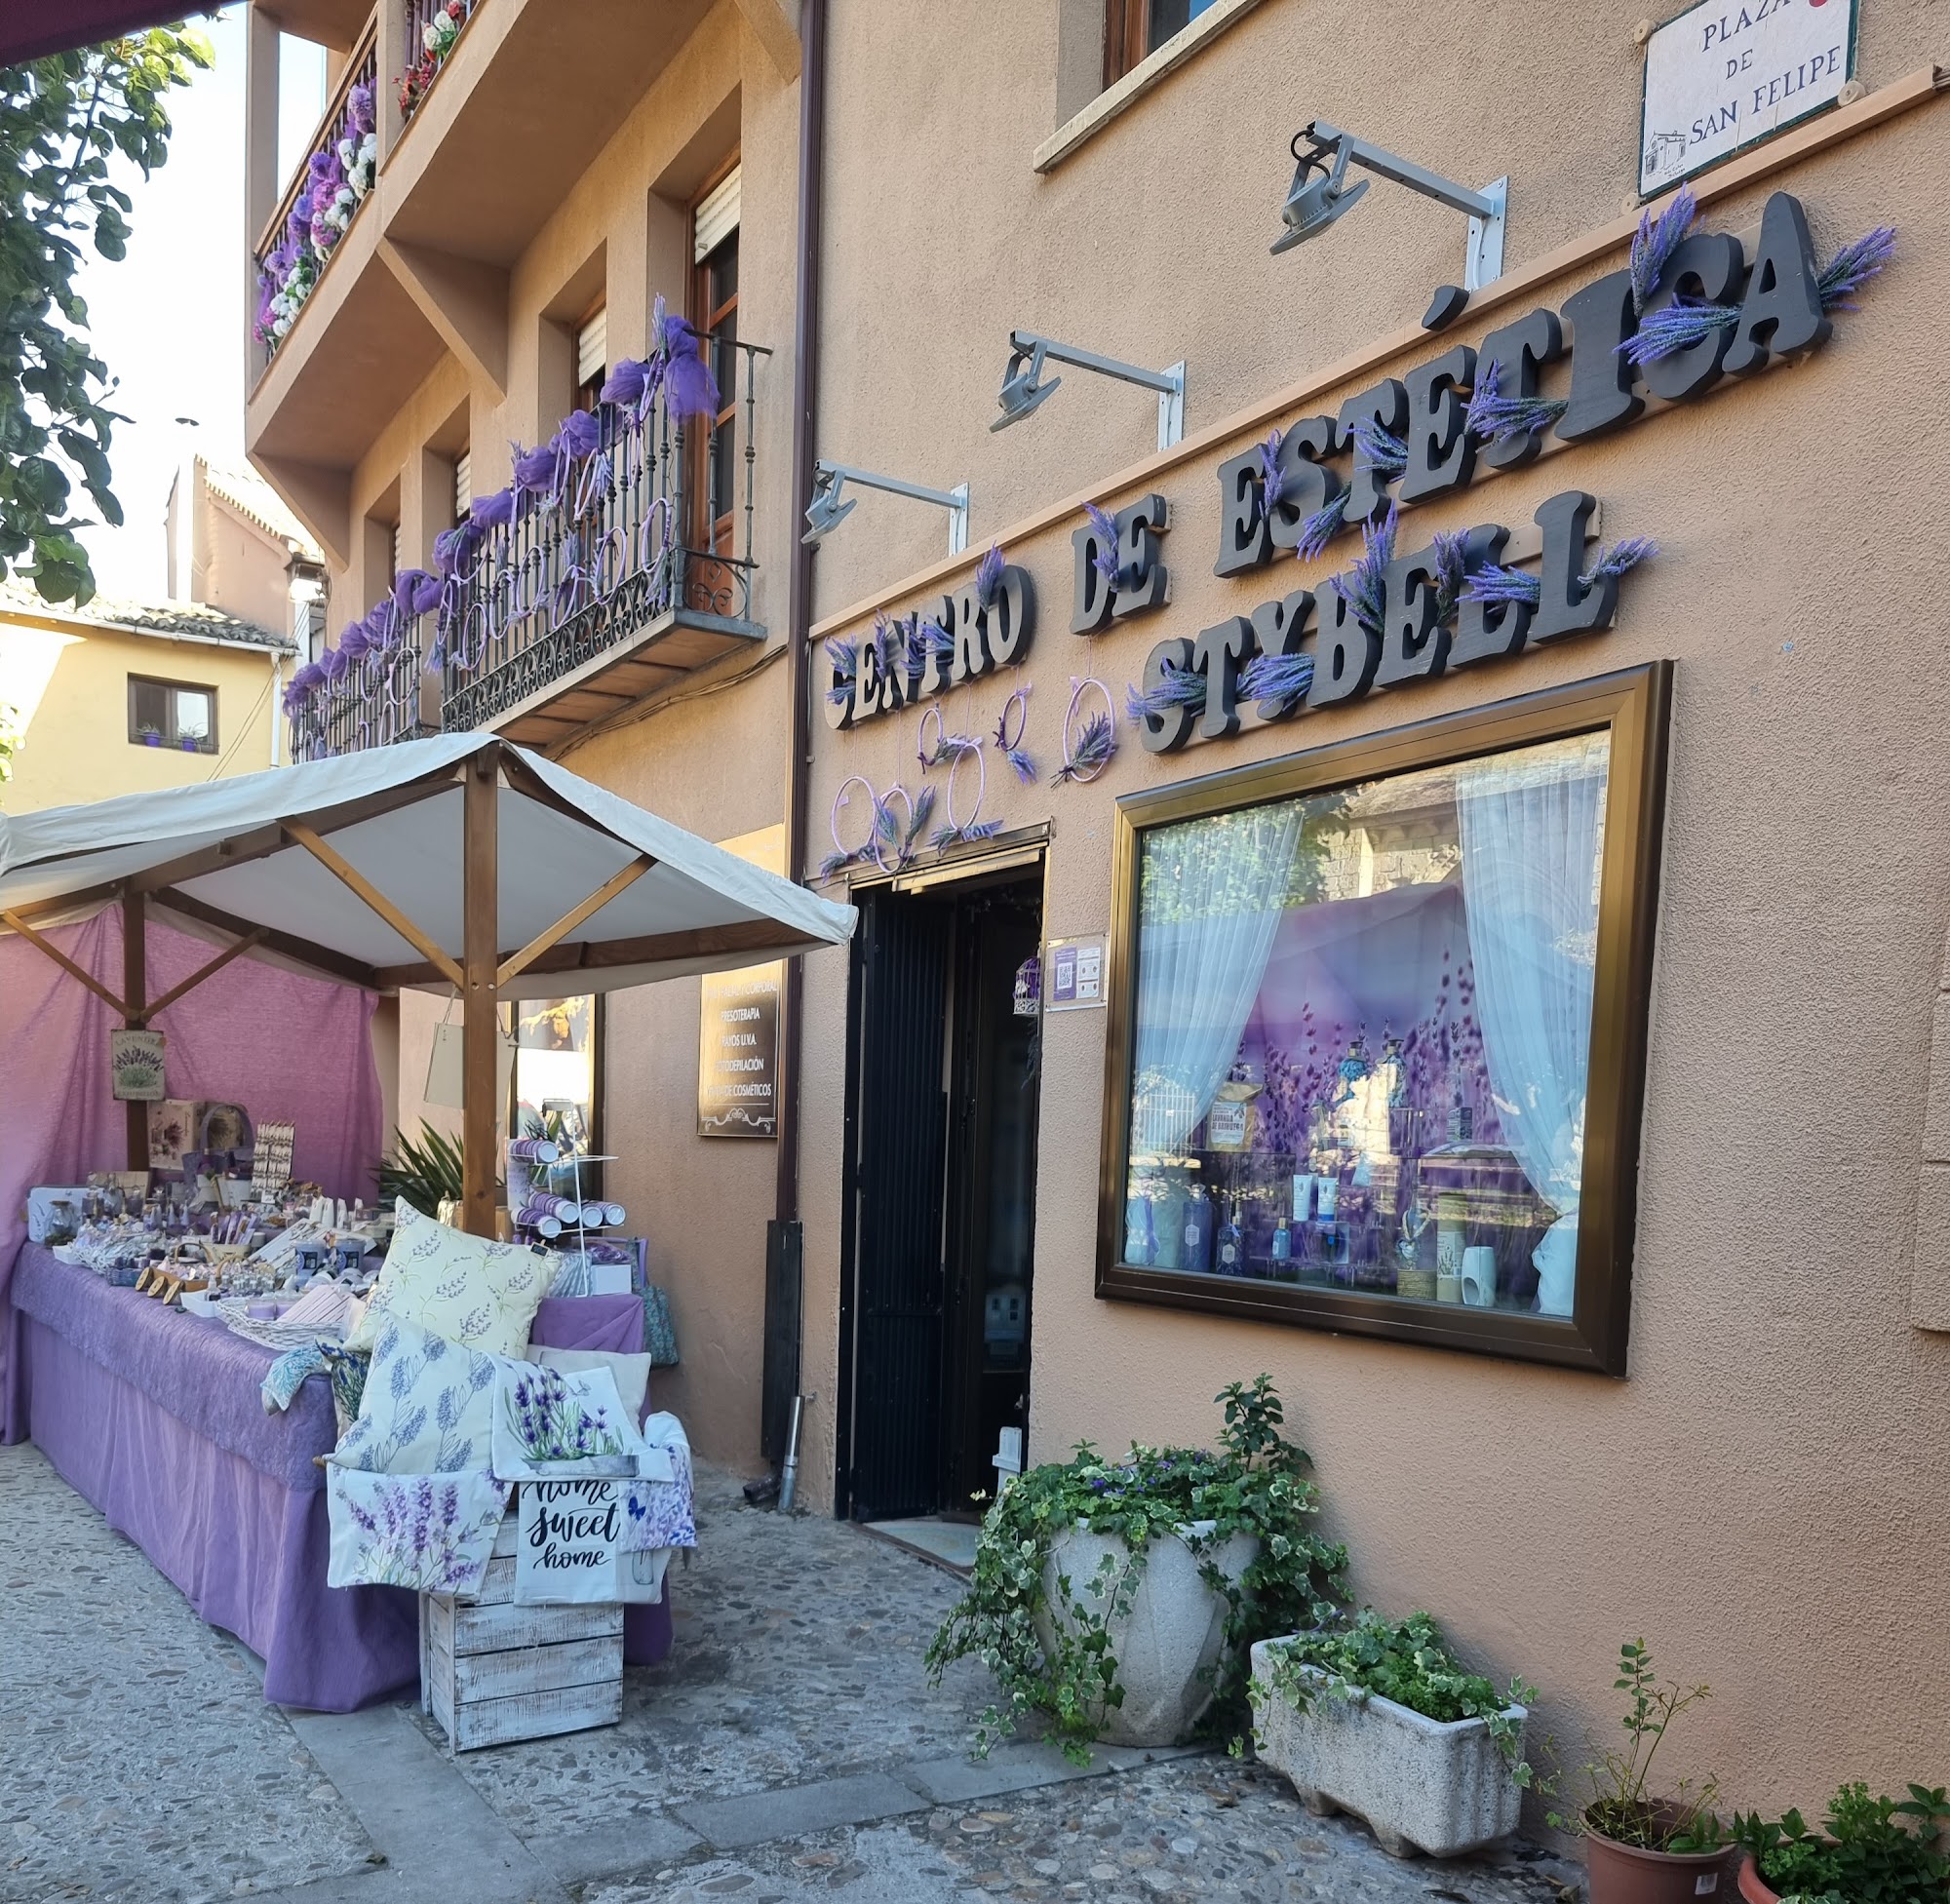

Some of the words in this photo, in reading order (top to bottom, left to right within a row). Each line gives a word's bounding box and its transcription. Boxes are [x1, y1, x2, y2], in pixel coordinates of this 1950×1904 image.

[1726, 49, 1753, 80] DE
[1689, 99, 1737, 146] SAN
[1751, 45, 1841, 115] FELIPE
[824, 564, 1036, 730] CENTRO
[1072, 493, 1167, 636] DE
[1213, 191, 1833, 579] ESTÉTICA
[1141, 490, 1619, 754] STYBELL
[722, 1007, 760, 1022] PRESOTERAPIA
[722, 1034, 740, 1047] RAYOS
[733, 1082, 772, 1097] COSMÉTICOS
[522, 1480, 618, 1505] home
[526, 1502, 621, 1547] sweet
[533, 1542, 611, 1569] home
